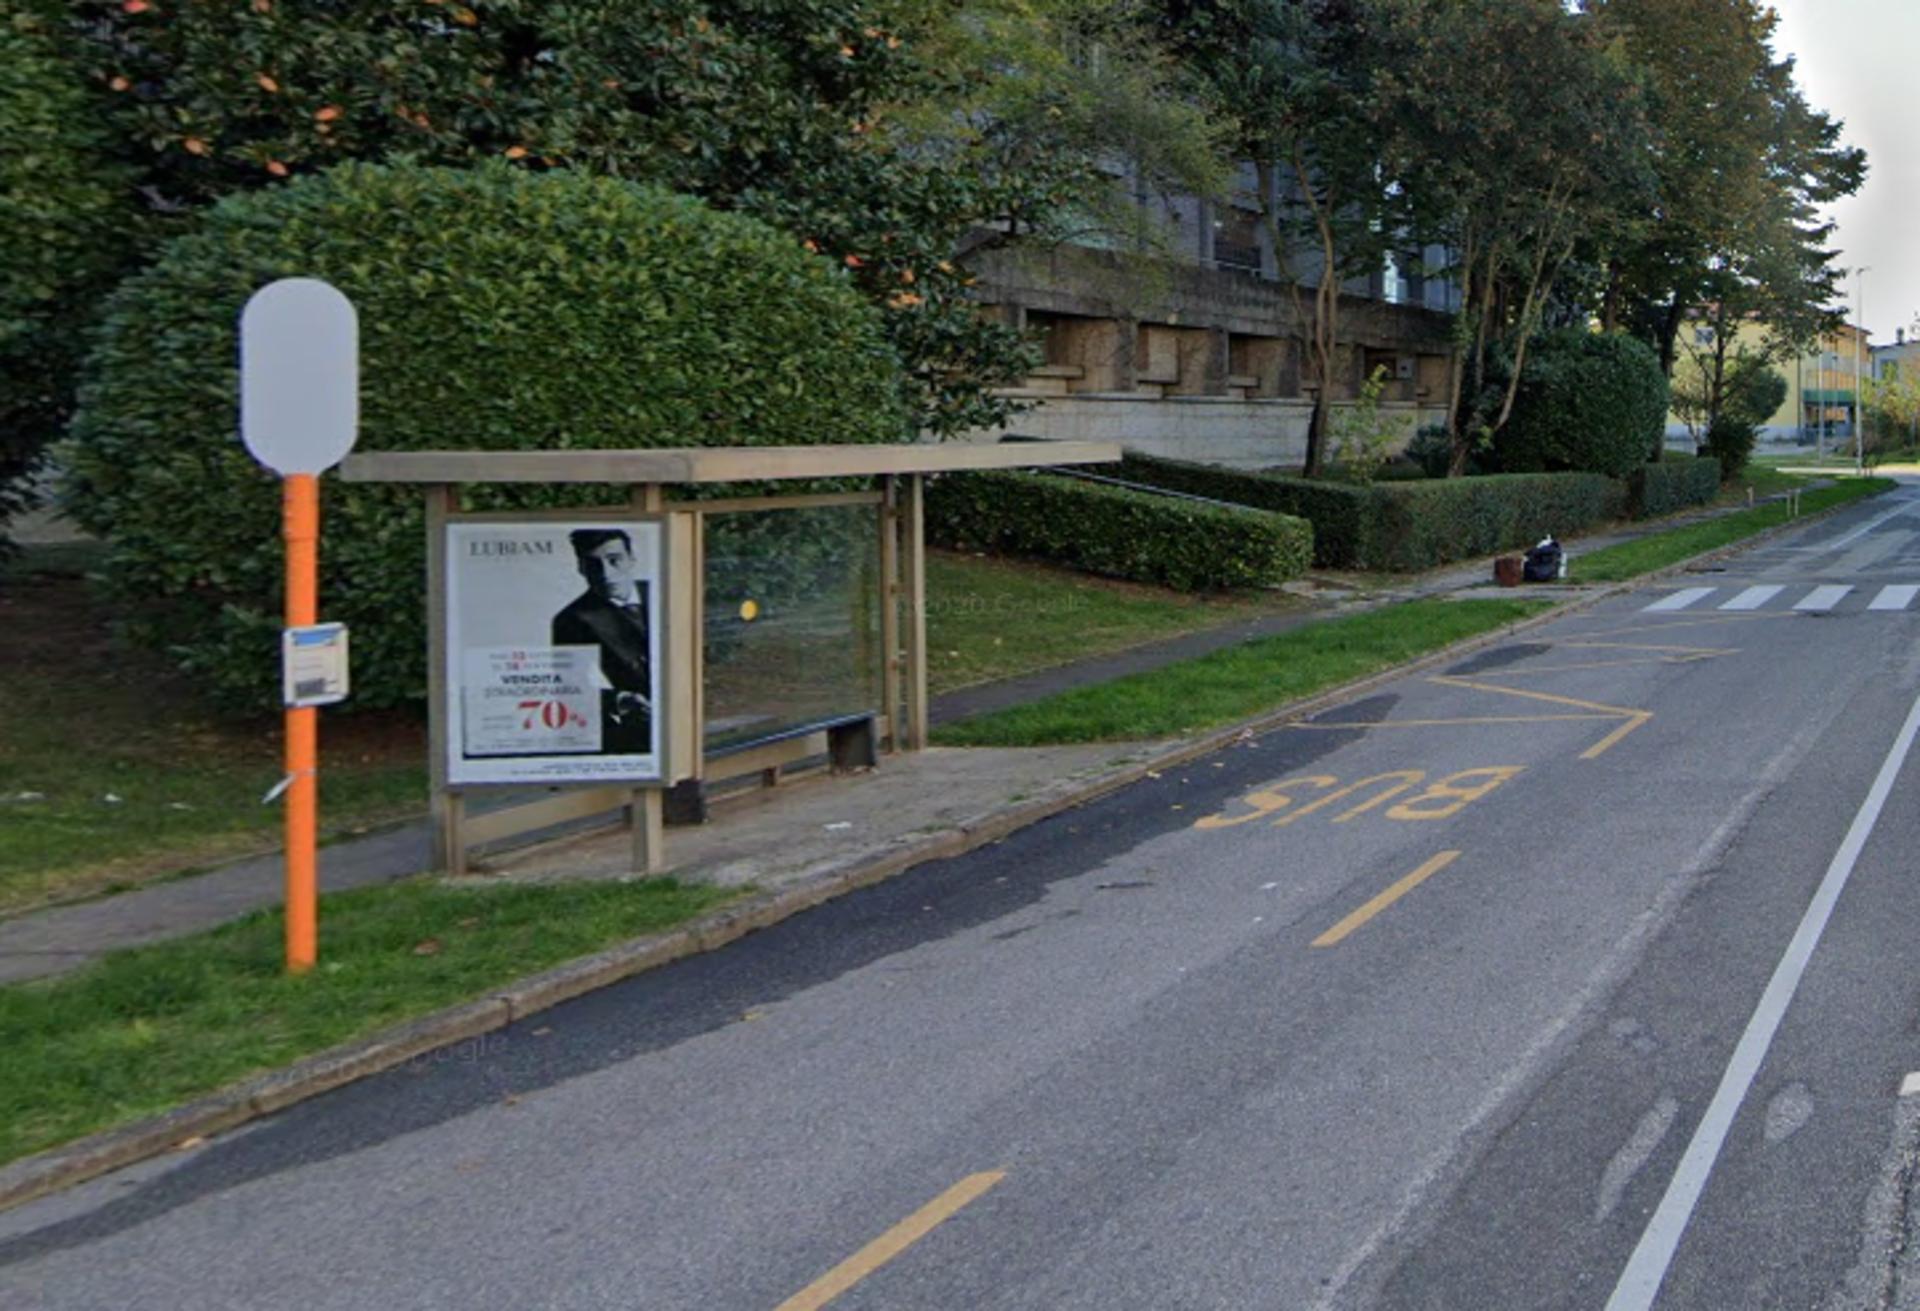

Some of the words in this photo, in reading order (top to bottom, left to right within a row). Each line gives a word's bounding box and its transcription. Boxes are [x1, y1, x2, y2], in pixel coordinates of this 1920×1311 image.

[470, 540, 553, 556] LUBIAM
[501, 674, 563, 685] VENDITA
[517, 700, 588, 730] 70%
[1193, 764, 1529, 829] BUS
